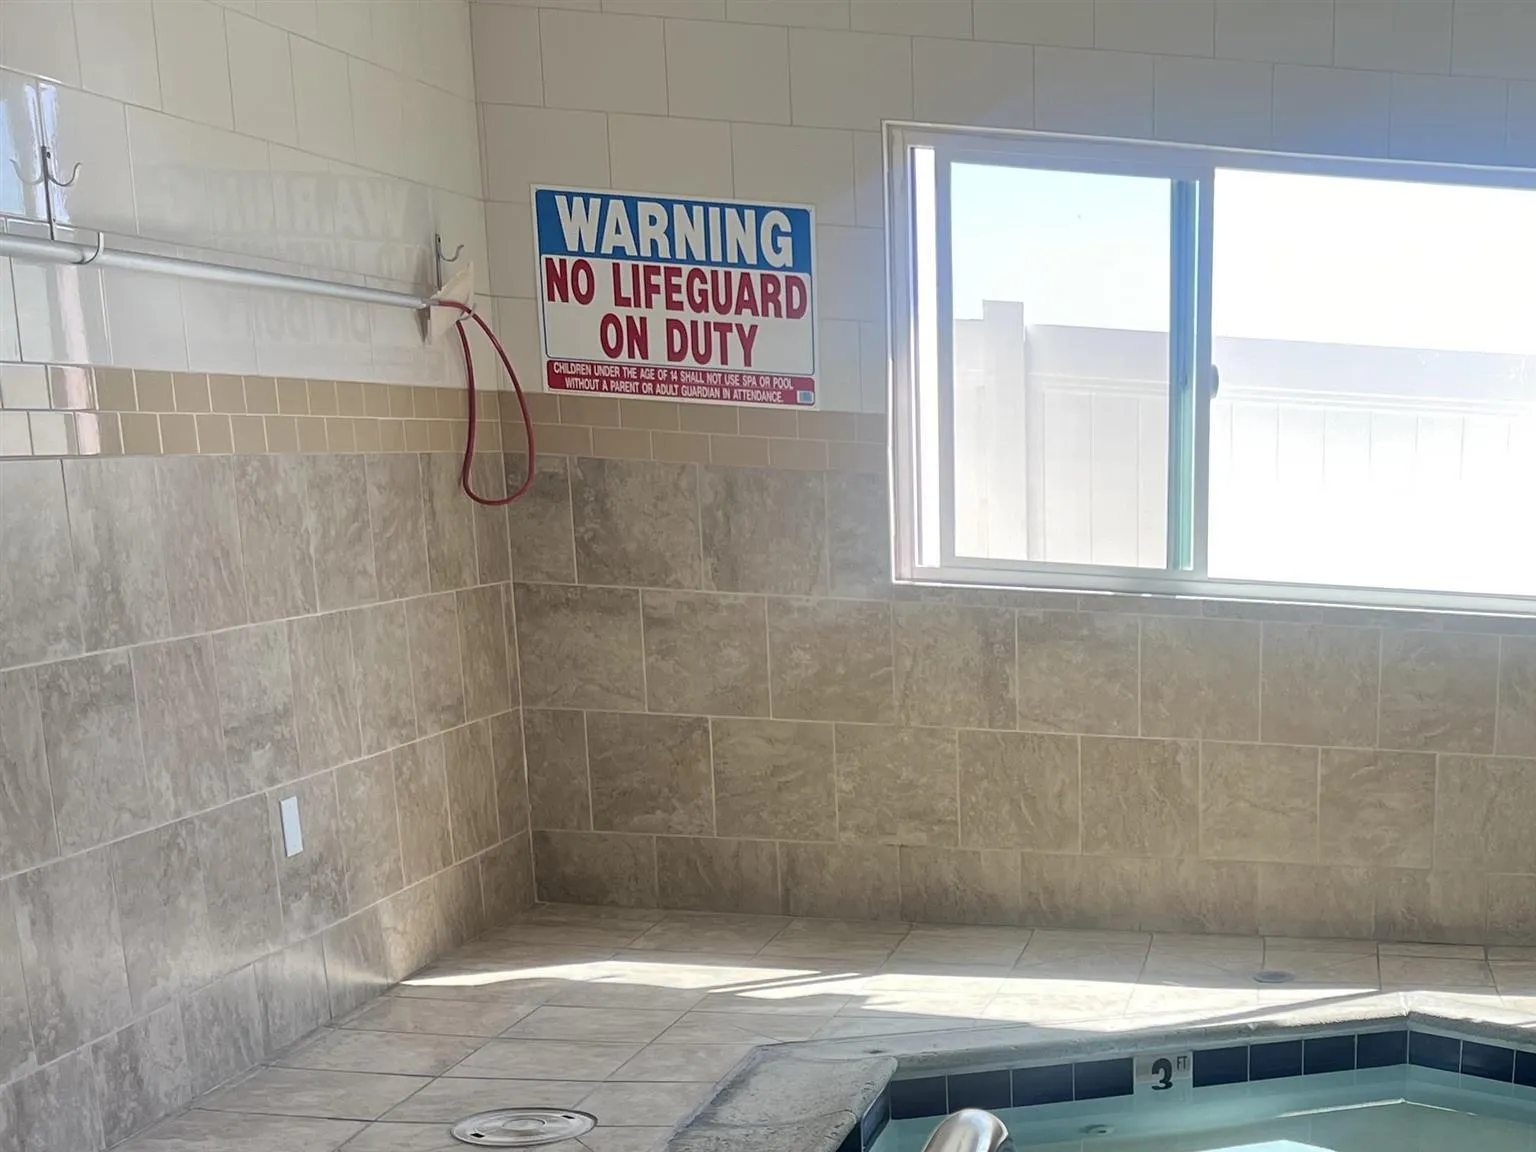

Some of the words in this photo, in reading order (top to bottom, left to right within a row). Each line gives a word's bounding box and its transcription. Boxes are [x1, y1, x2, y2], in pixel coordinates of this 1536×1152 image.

[555, 195, 793, 268] WARNING
[545, 257, 595, 305] NO
[612, 262, 807, 319] LIFEGUARD
[600, 313, 648, 360] ON
[666, 318, 758, 367] DUTY
[553, 362, 592, 375] CHILDREN
[594, 365, 621, 378] UNDER
[623, 367, 638, 379] THE
[640, 368, 656, 380] AGE
[657, 369, 668, 380] OF
[670, 370, 678, 381] 14
[680, 371, 704, 383] SHALL
[707, 373, 722, 385] NOT
[724, 374, 740, 386] USE
[742, 375, 757, 387] SPA
[760, 376, 771, 388] OR
[773, 377, 794, 389] POOL
[565, 377, 599, 391] WITHOUT
[602, 379, 609, 391] A
[610, 380, 641, 393] PARENT
[641, 382, 653, 394] OR
[656, 383, 680, 396] ADULT
[681, 385, 720, 399] GUARDIAN
[722, 388, 731, 399] IN
[1152, 1058, 1173, 1090] 3
[1177, 1056, 1188, 1070] FT
